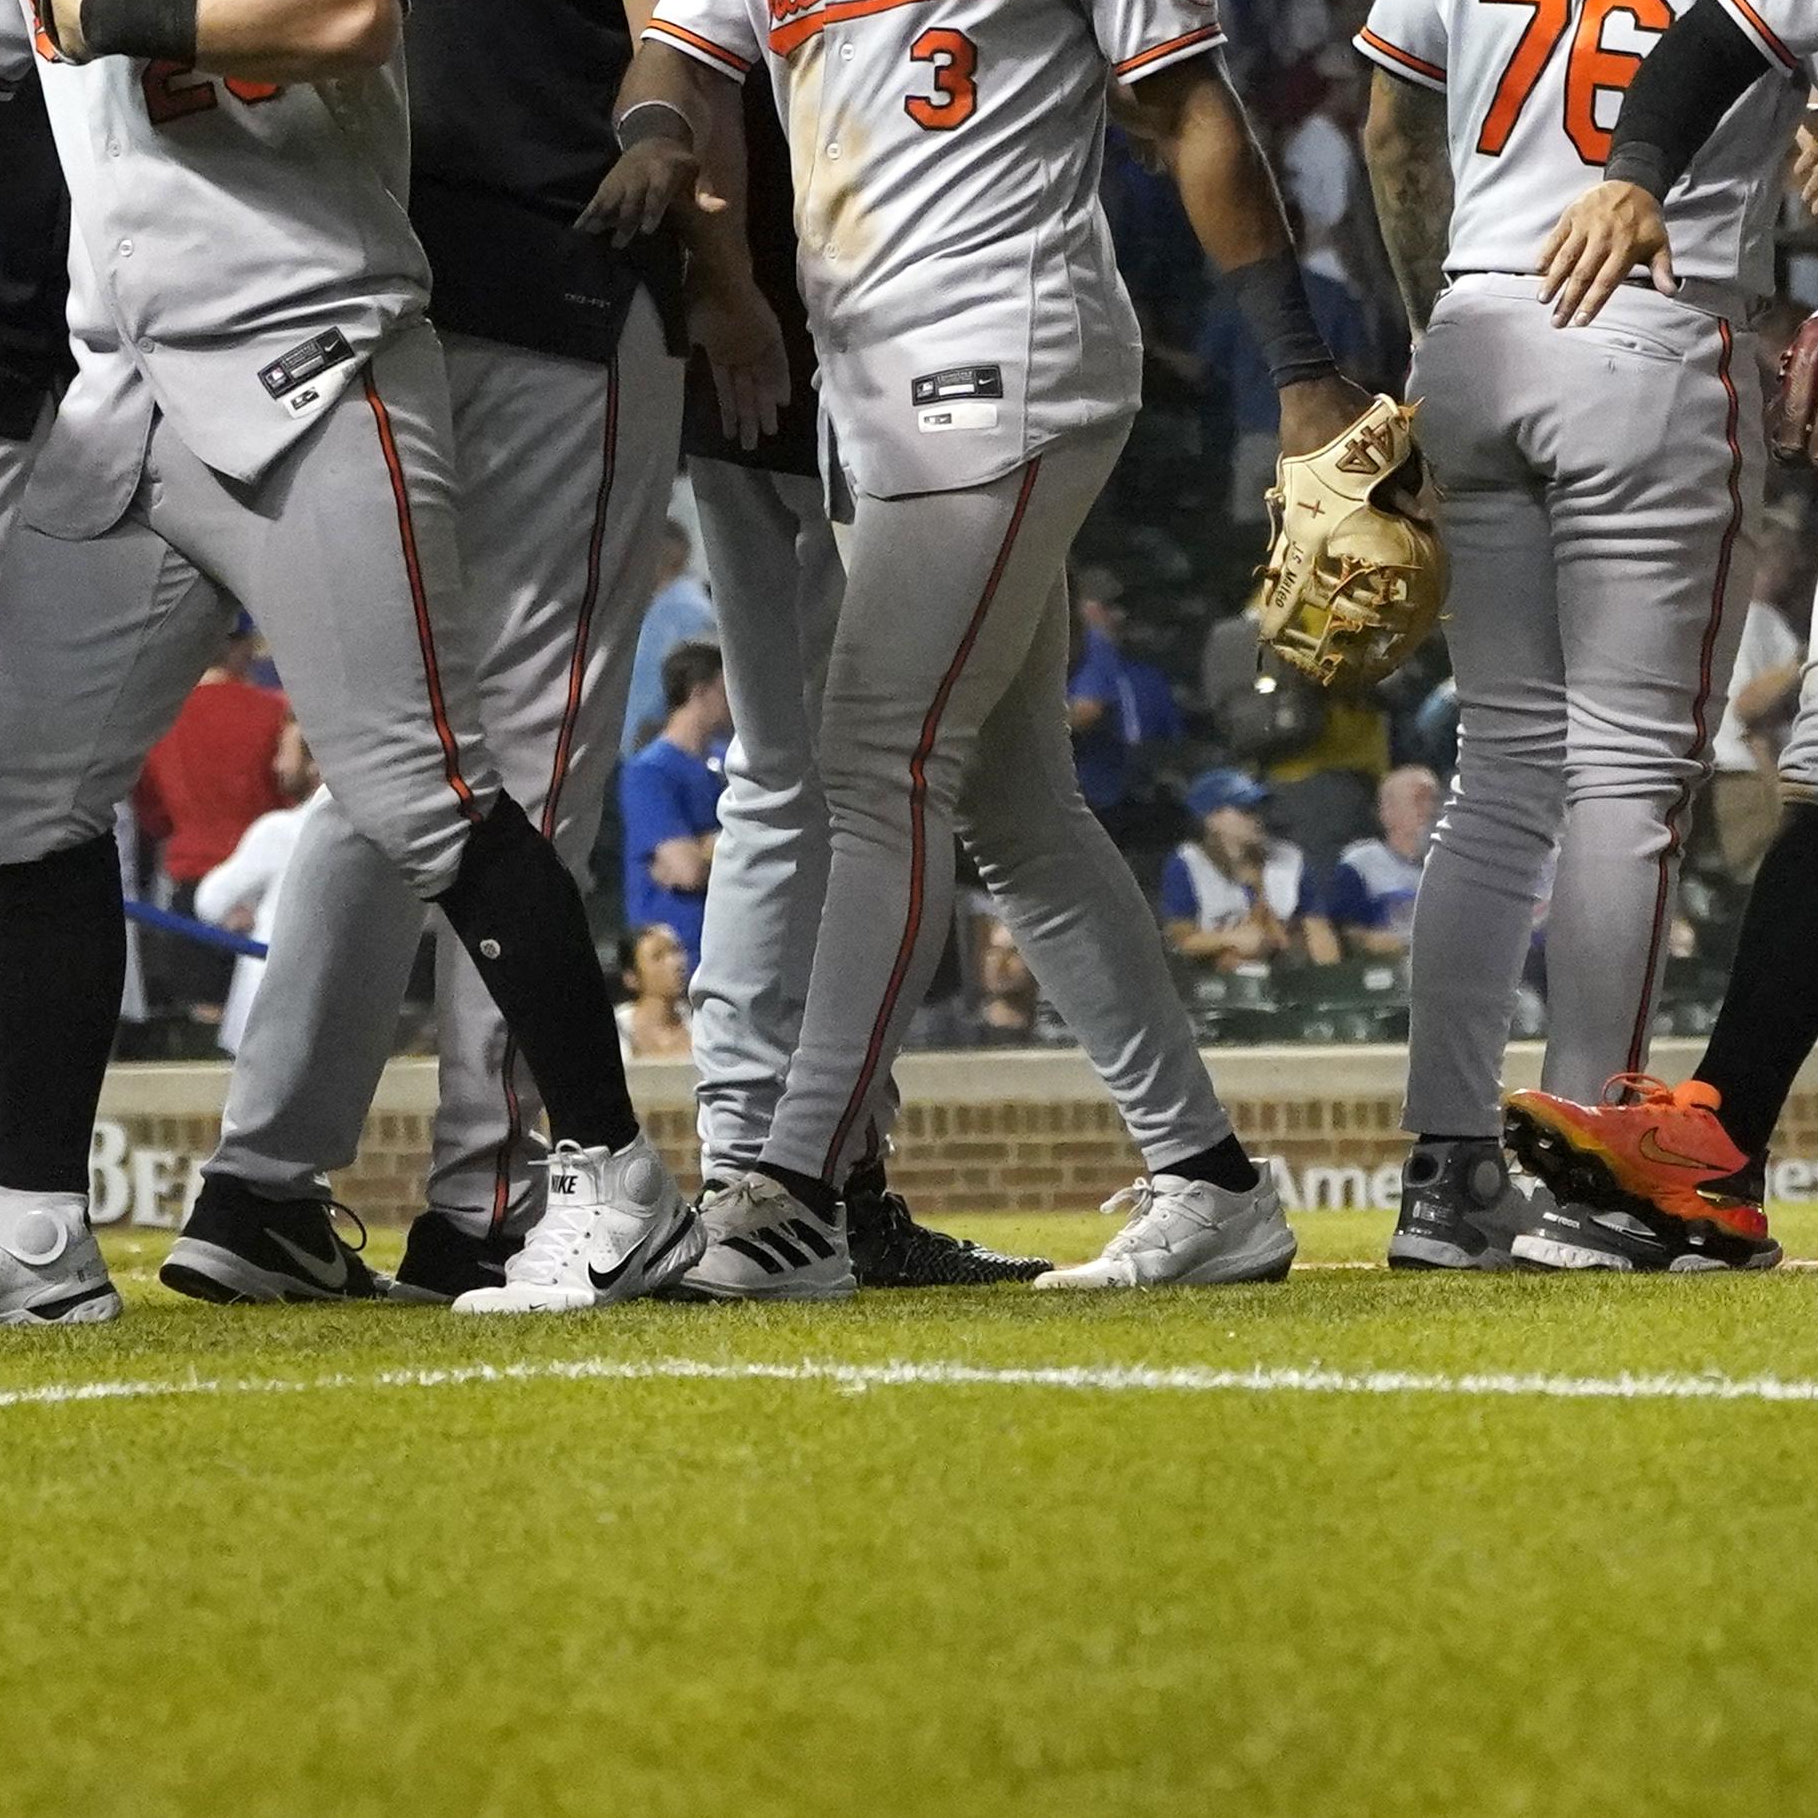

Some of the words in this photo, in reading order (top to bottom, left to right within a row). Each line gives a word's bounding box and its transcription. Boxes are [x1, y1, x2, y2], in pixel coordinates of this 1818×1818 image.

[141, 58, 281, 125] 2
[903, 27, 978, 131] 3
[1275, 566, 1298, 609] Mateo
